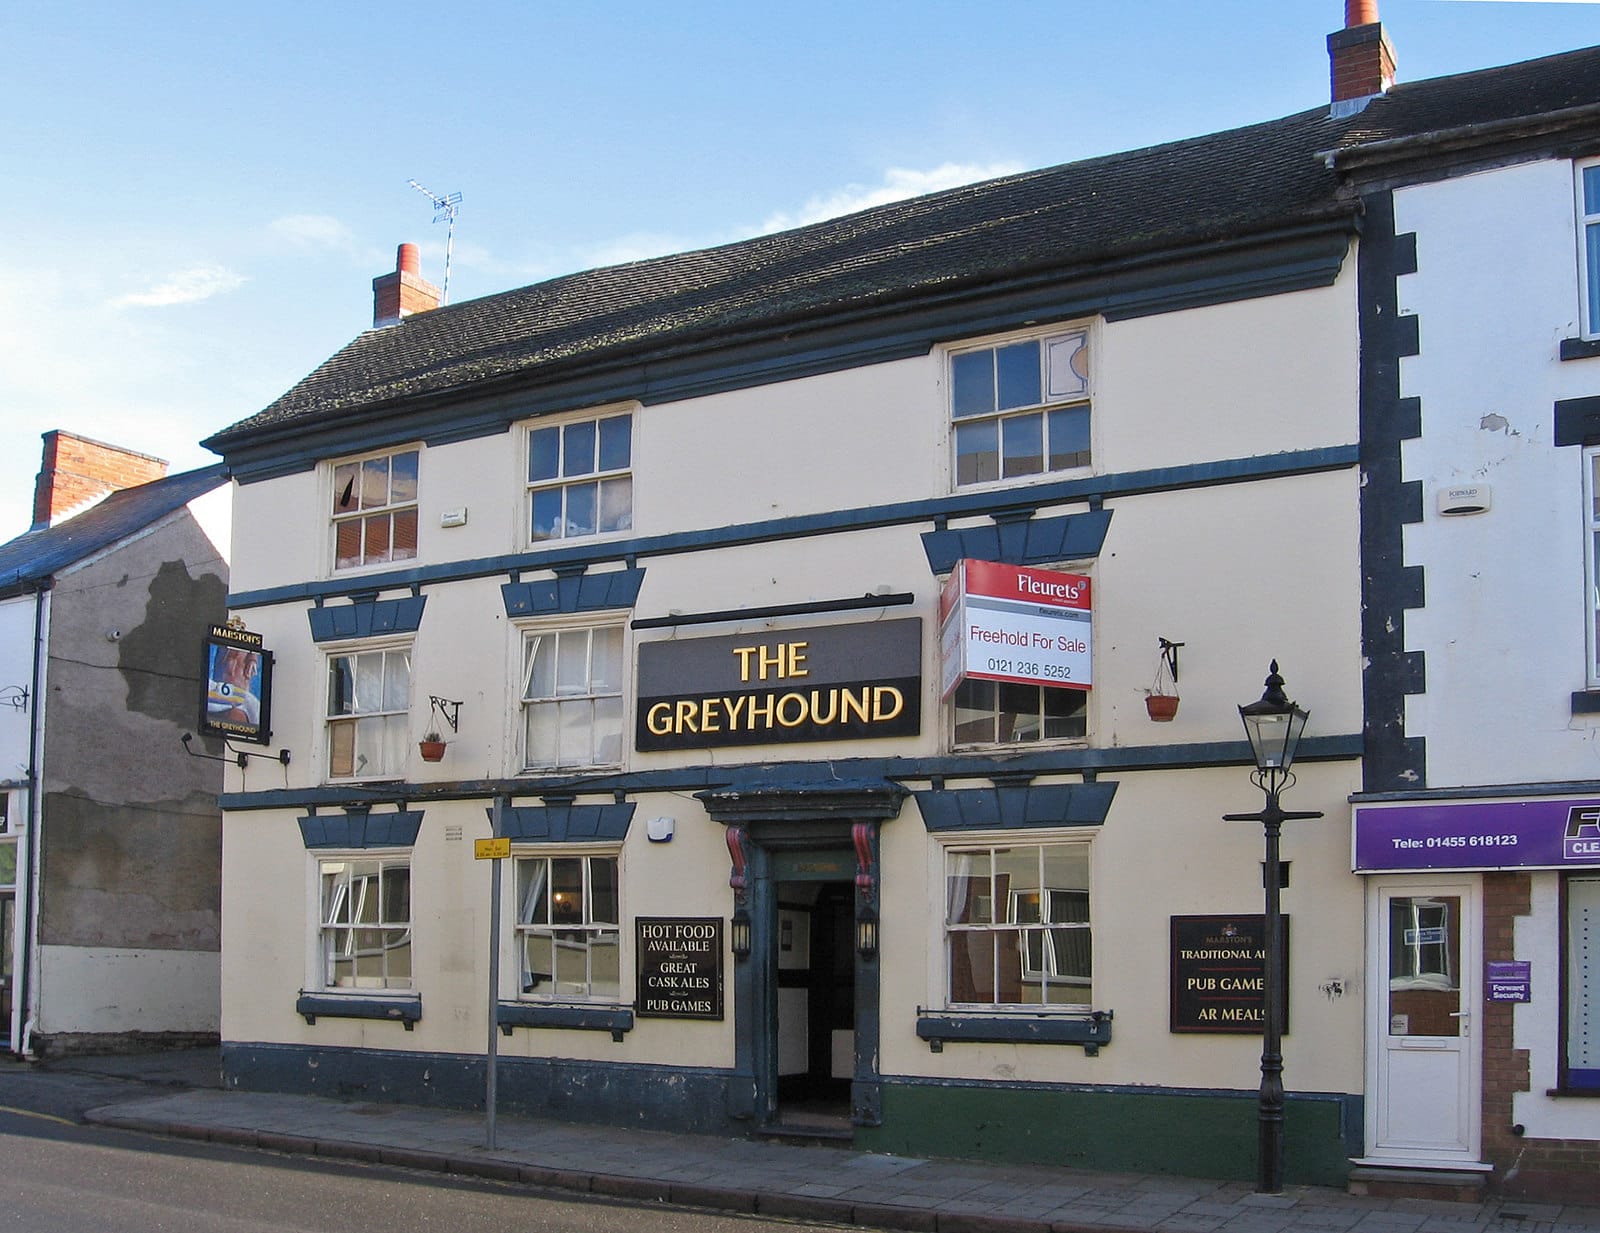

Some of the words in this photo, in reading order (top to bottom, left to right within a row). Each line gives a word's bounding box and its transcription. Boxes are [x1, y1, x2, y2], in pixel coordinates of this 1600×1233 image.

[1017, 574, 1079, 600] Fleurets
[213, 627, 260, 645] MARSTON'S
[970, 625, 1028, 648] Freehold
[1032, 633, 1054, 650] For
[1057, 636, 1086, 654] Sale
[733, 642, 808, 681] THE
[988, 658, 1013, 673] 0121
[1017, 661, 1039, 676] 236
[1044, 664, 1071, 679] 5252
[221, 682, 230, 696] 6
[647, 686, 904, 735] GREYHOUND
[210, 721, 221, 729] THE
[221, 722, 256, 734] GREYHOUND
[1392, 838, 1423, 849] Tele:
[1426, 837, 1466, 848] 01455
[1469, 834, 1518, 847] 618123
[642, 925, 672, 938] HOT
[675, 925, 715, 939] FOOD
[648, 940, 710, 952] AVAILABLE
[1181, 950, 1252, 960] TRADITIONAL
[660, 962, 698, 974] GREAT
[648, 976, 679, 988] CASK
[680, 977, 710, 989] ALES
[1187, 978, 1216, 990] PUB
[1493, 991, 1525, 1000] Security
[647, 999, 669, 1010] PUB
[671, 1000, 711, 1012] GAMES
[1198, 1008, 1218, 1021] AR
